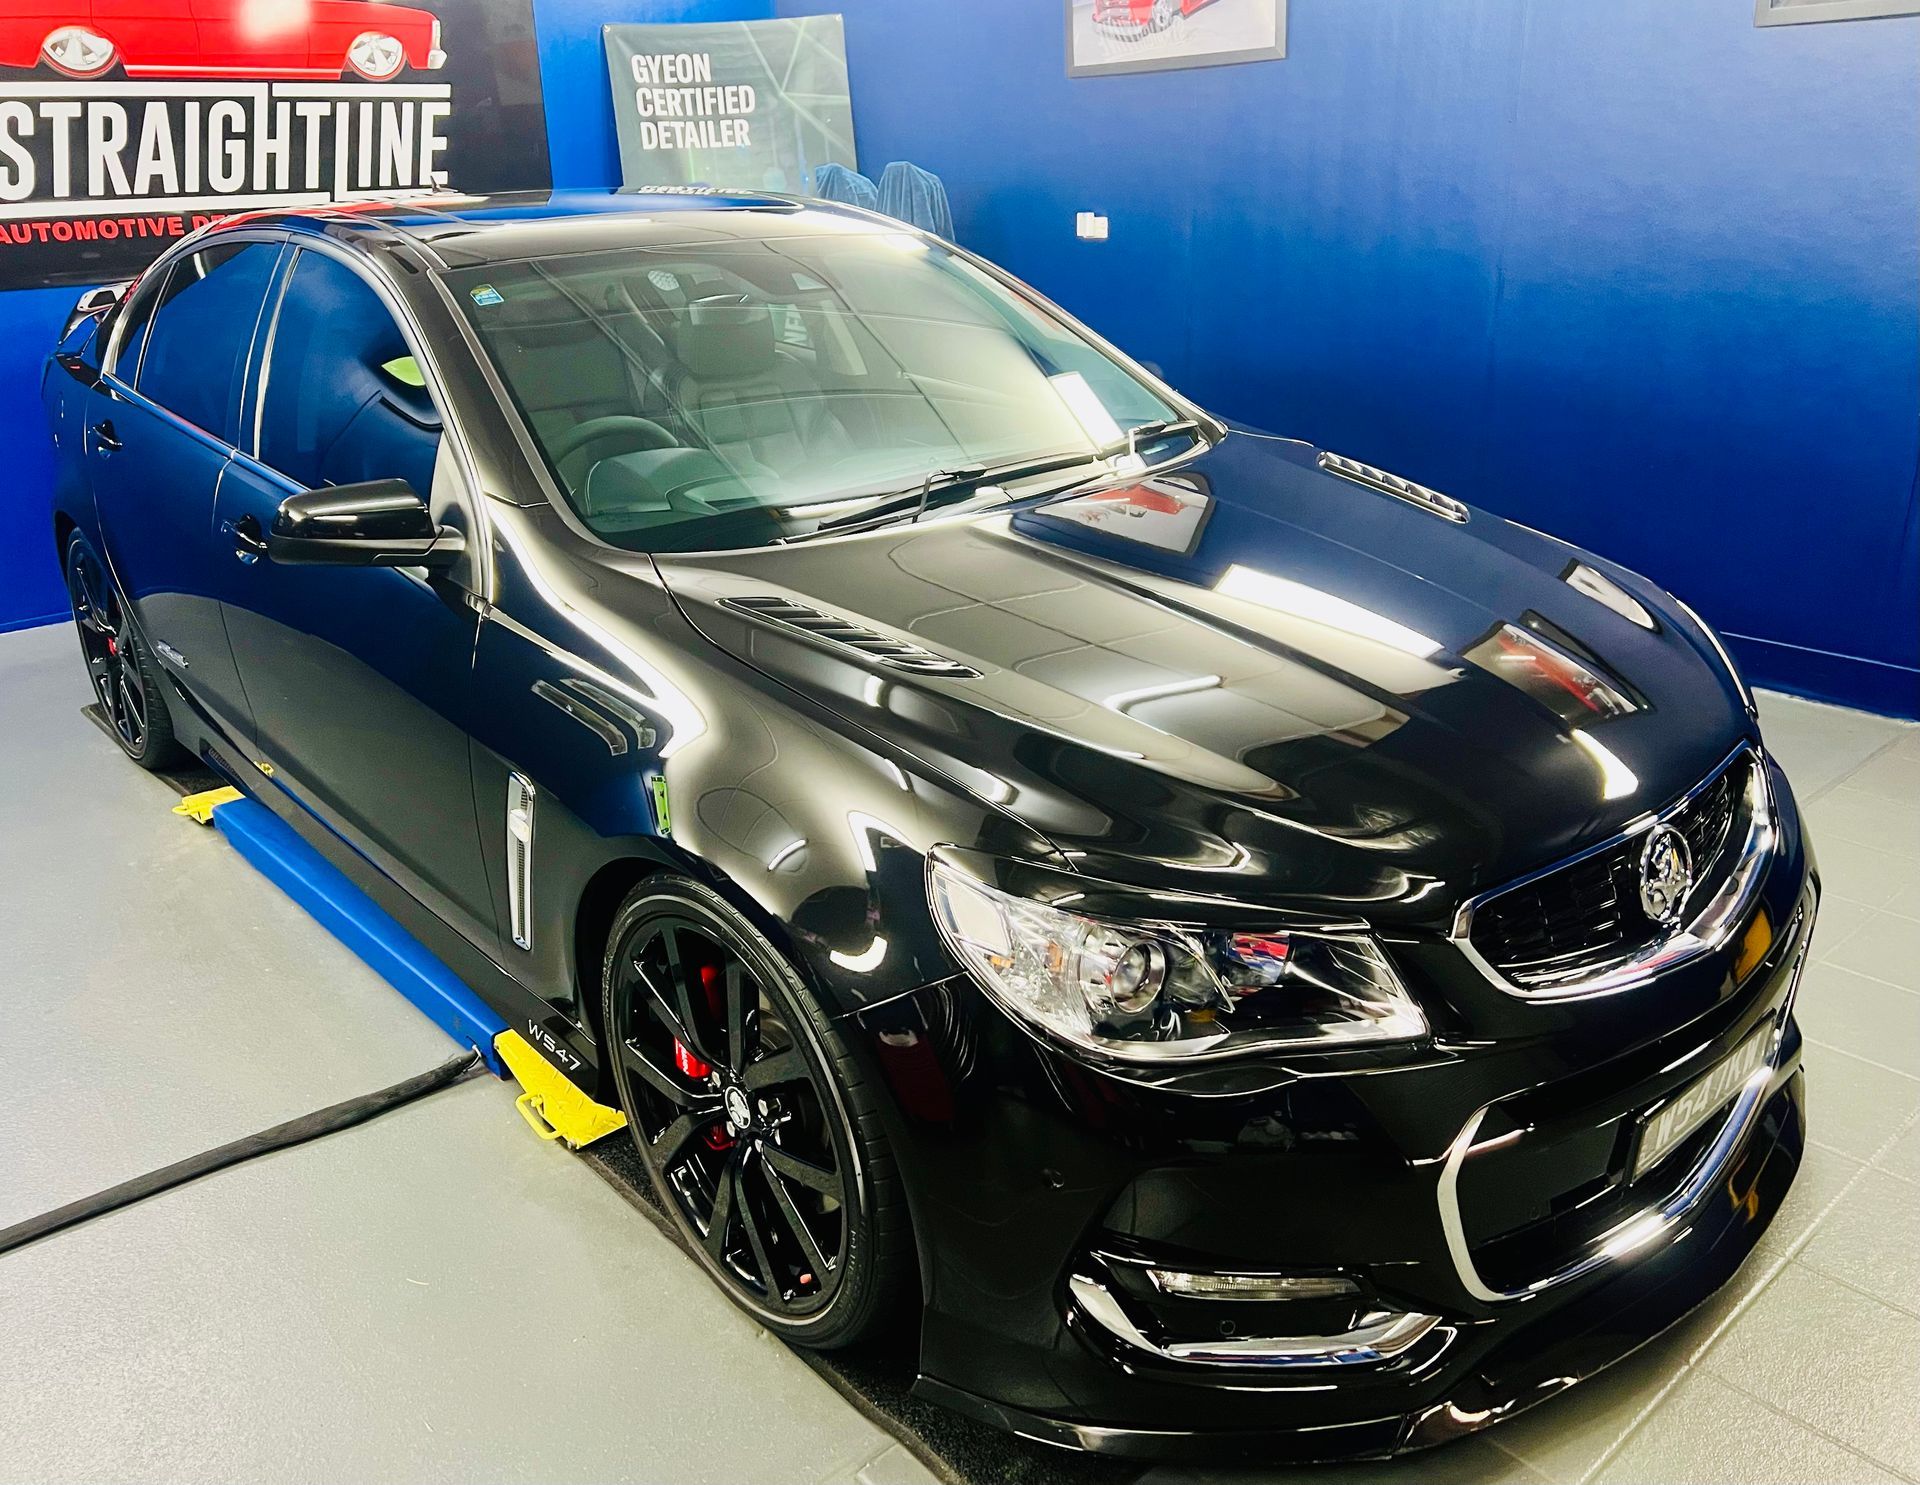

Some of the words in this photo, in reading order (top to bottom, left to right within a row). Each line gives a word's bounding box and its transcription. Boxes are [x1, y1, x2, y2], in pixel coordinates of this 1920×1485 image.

[630, 53, 712, 84] GYEON
[635, 85, 756, 117] CERTIFIED
[0, 99, 451, 201] STRAIGHTLINE
[640, 119, 752, 150] DETAILER
[0, 216, 185, 244] AUTOMOTIVE
